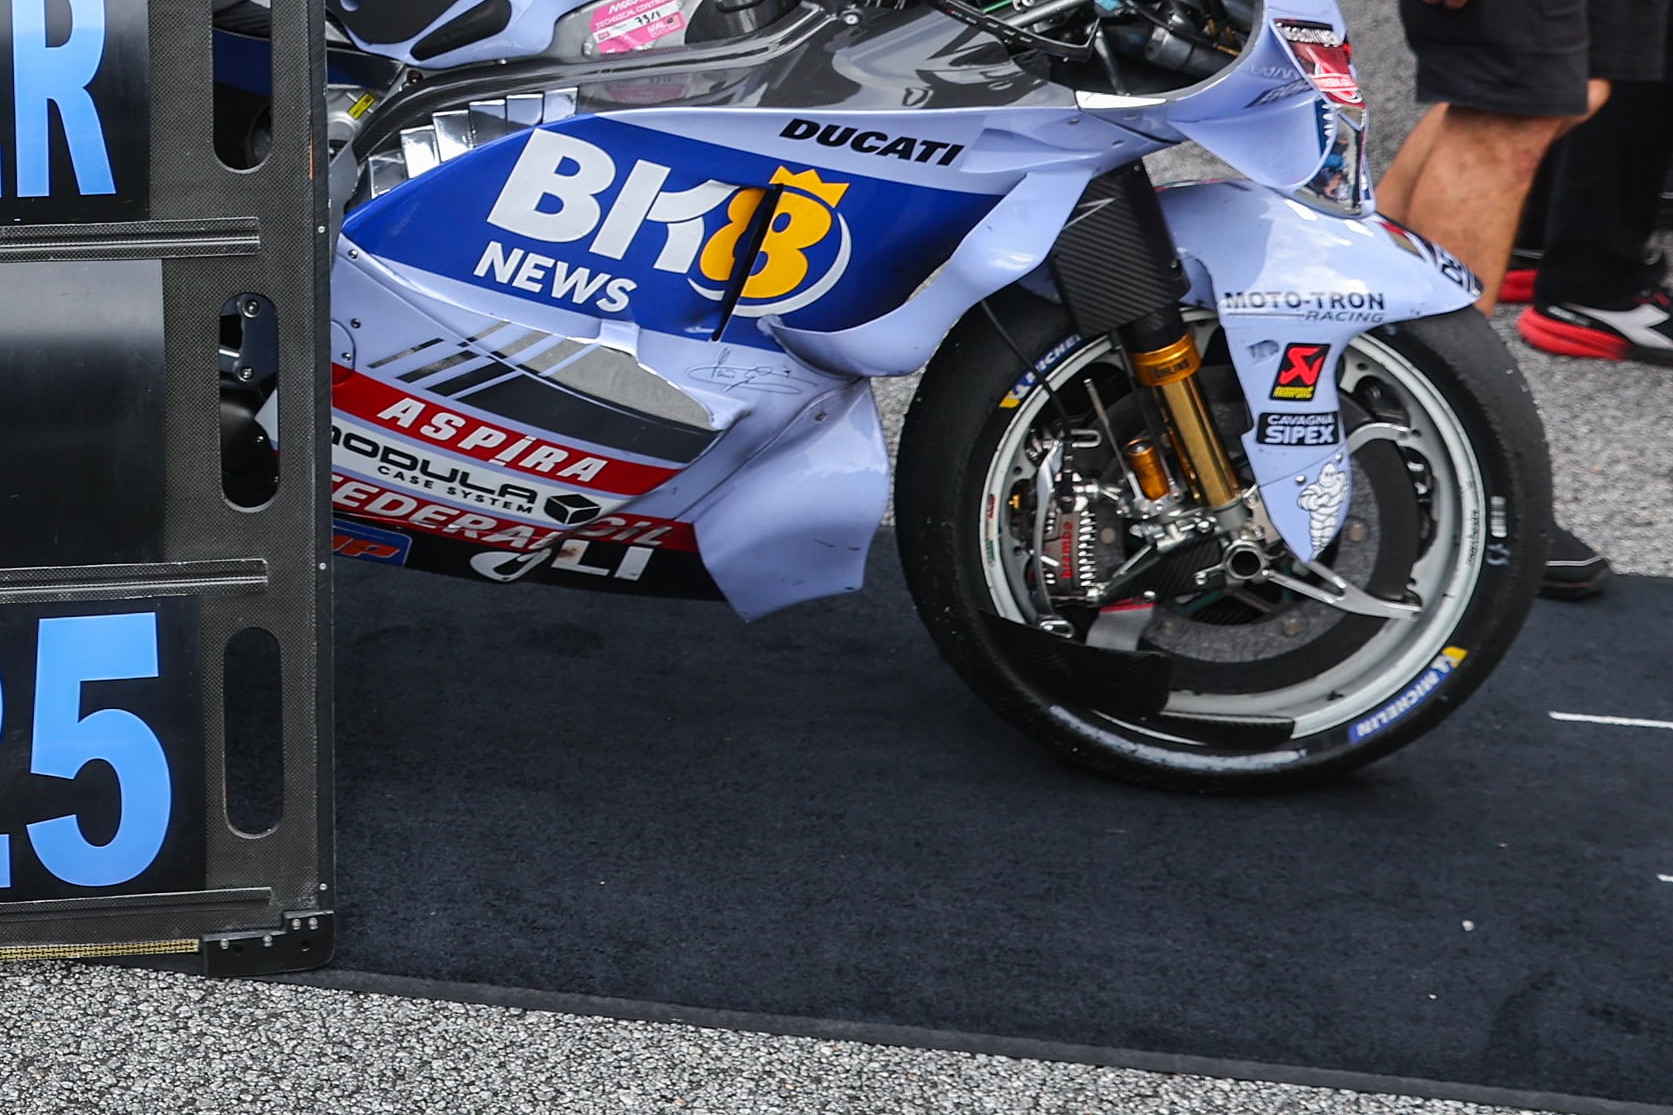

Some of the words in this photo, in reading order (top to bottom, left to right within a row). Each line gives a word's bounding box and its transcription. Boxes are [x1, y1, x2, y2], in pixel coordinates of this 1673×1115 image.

[778, 117, 966, 168] DUCATI
[486, 128, 851, 317] BK8
[474, 240, 637, 313] NEWS
[1224, 292, 1385, 310] MOTO-TRON
[1304, 311, 1384, 323] RACING
[1264, 426, 1334, 444] SIPEX
[1267, 415, 1335, 425] CAVAGNA
[378, 465, 437, 489] CASE
[447, 486, 534, 514] SYSTEM
[470, 538, 654, 582] OLI
[1061, 521, 1074, 579] brembo
[1356, 675, 1440, 737] MICHELIN
